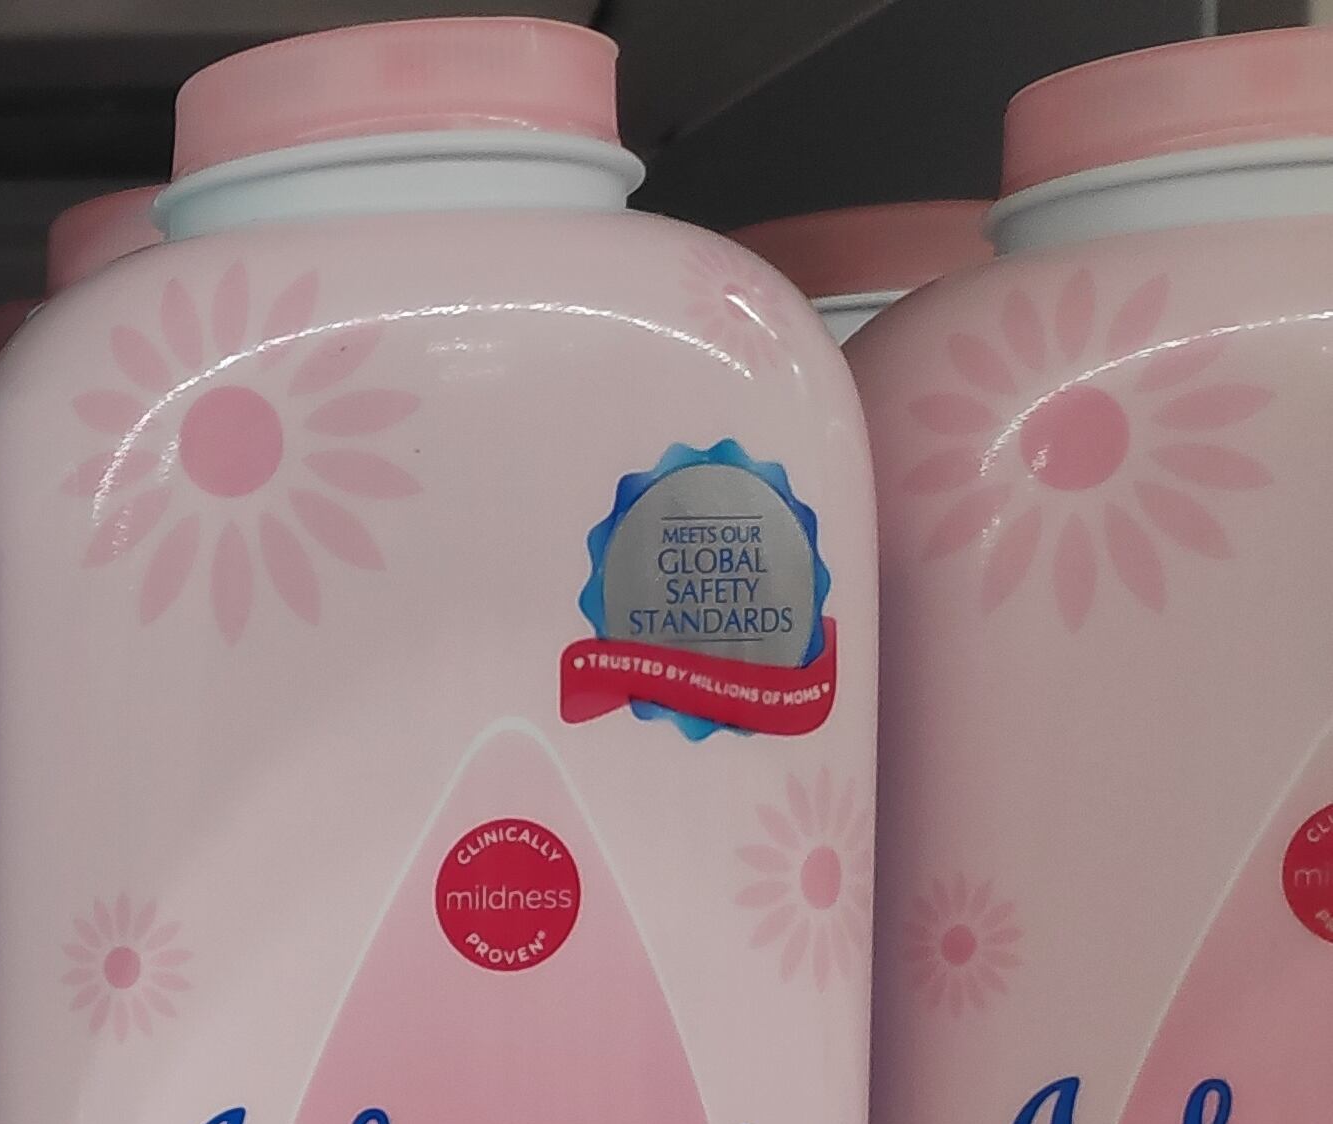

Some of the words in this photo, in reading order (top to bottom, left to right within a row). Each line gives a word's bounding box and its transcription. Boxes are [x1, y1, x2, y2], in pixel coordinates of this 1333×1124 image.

[662, 526, 717, 544] MEETS
[721, 525, 762, 543] OUR
[657, 548, 767, 574] GLOBAL
[666, 578, 760, 604] SAFETY
[629, 607, 793, 635] STANDARDS
[588, 653, 663, 677] TRUSTED
[666, 665, 688, 682] BY
[690, 672, 759, 704] MILLIONS
[762, 690, 781, 705] OF
[784, 685, 821, 706] MOMS
[457, 826, 562, 865] CLINICALLY
[446, 884, 572, 910] mildness
